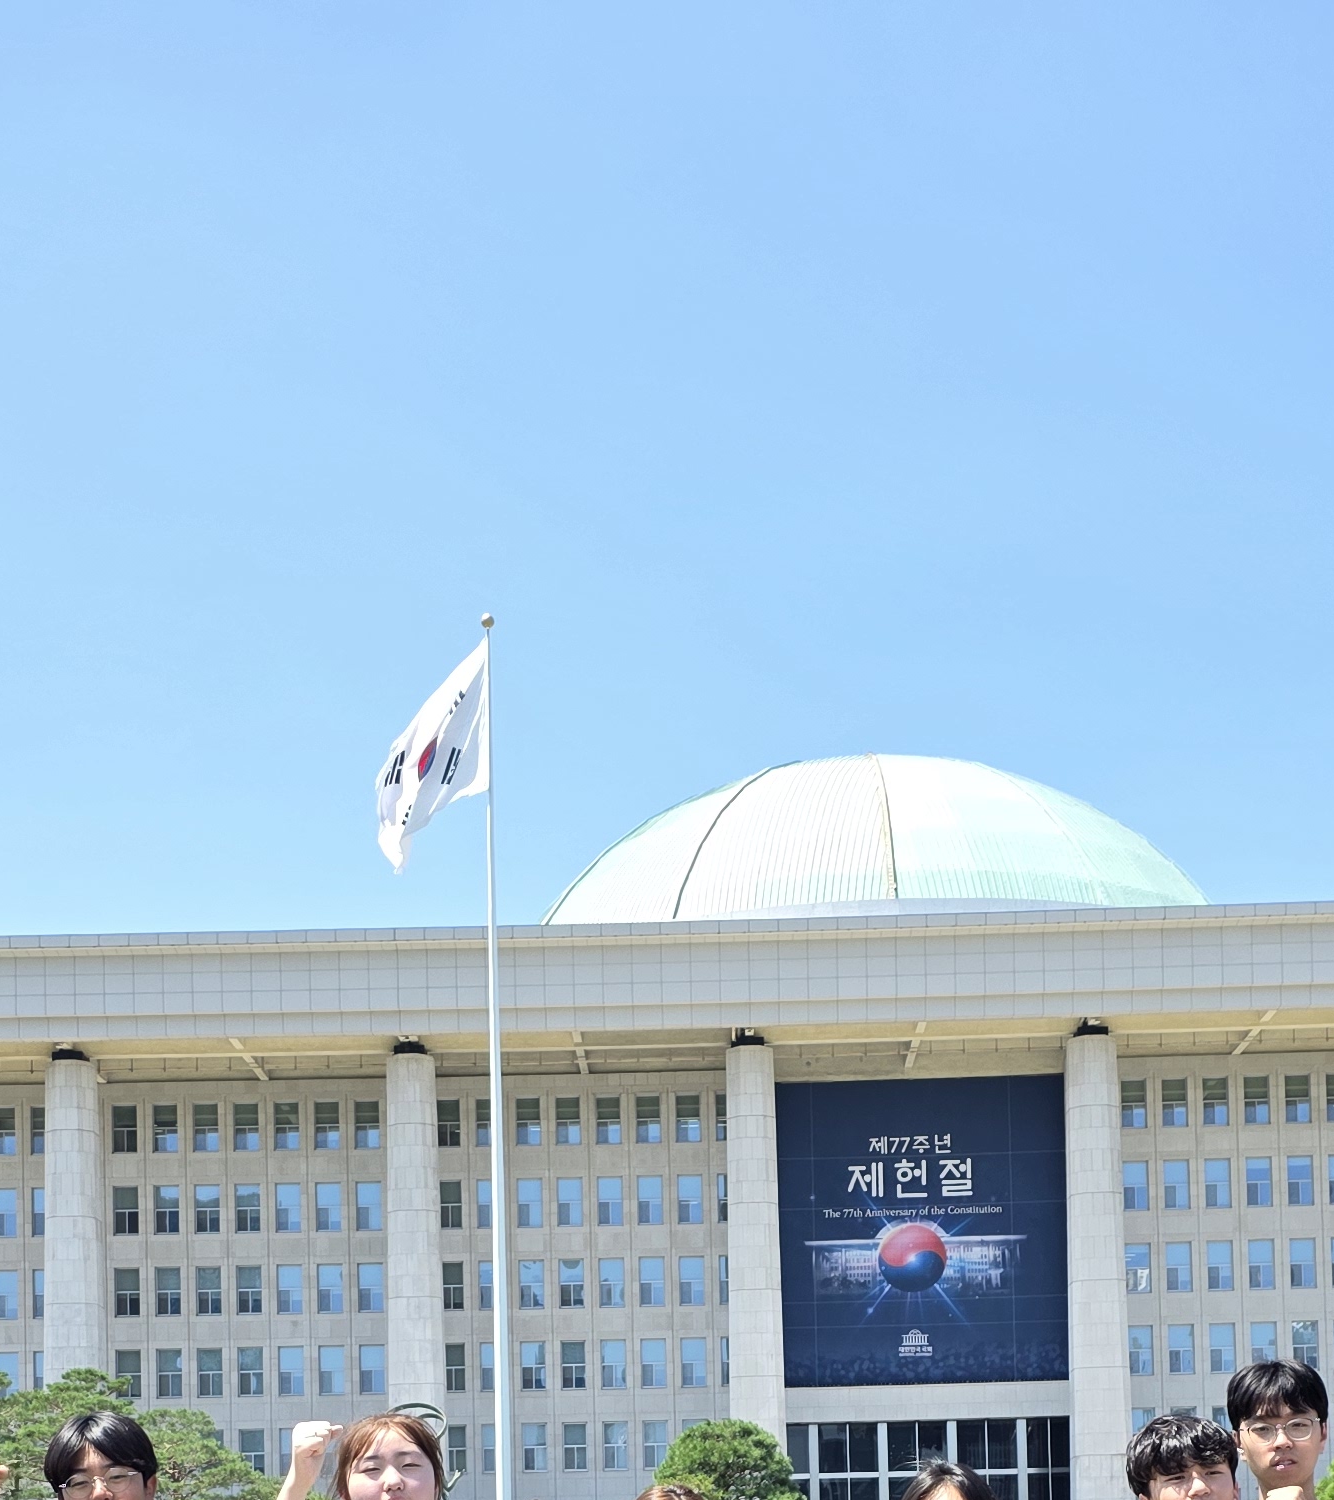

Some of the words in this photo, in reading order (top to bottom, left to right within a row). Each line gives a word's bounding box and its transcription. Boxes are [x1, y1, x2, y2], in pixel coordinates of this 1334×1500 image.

[869, 1133, 951, 1154] 제77주년
[847, 1157, 973, 1199] 제헌절
[823, 1209, 841, 1218] The
[843, 1208, 863, 1217] 77th
[865, 1207, 917, 1217] Anniversary
[919, 1206, 929, 1215] of
[931, 1206, 945, 1215] the
[947, 1205, 1003, 1215] Constitution
